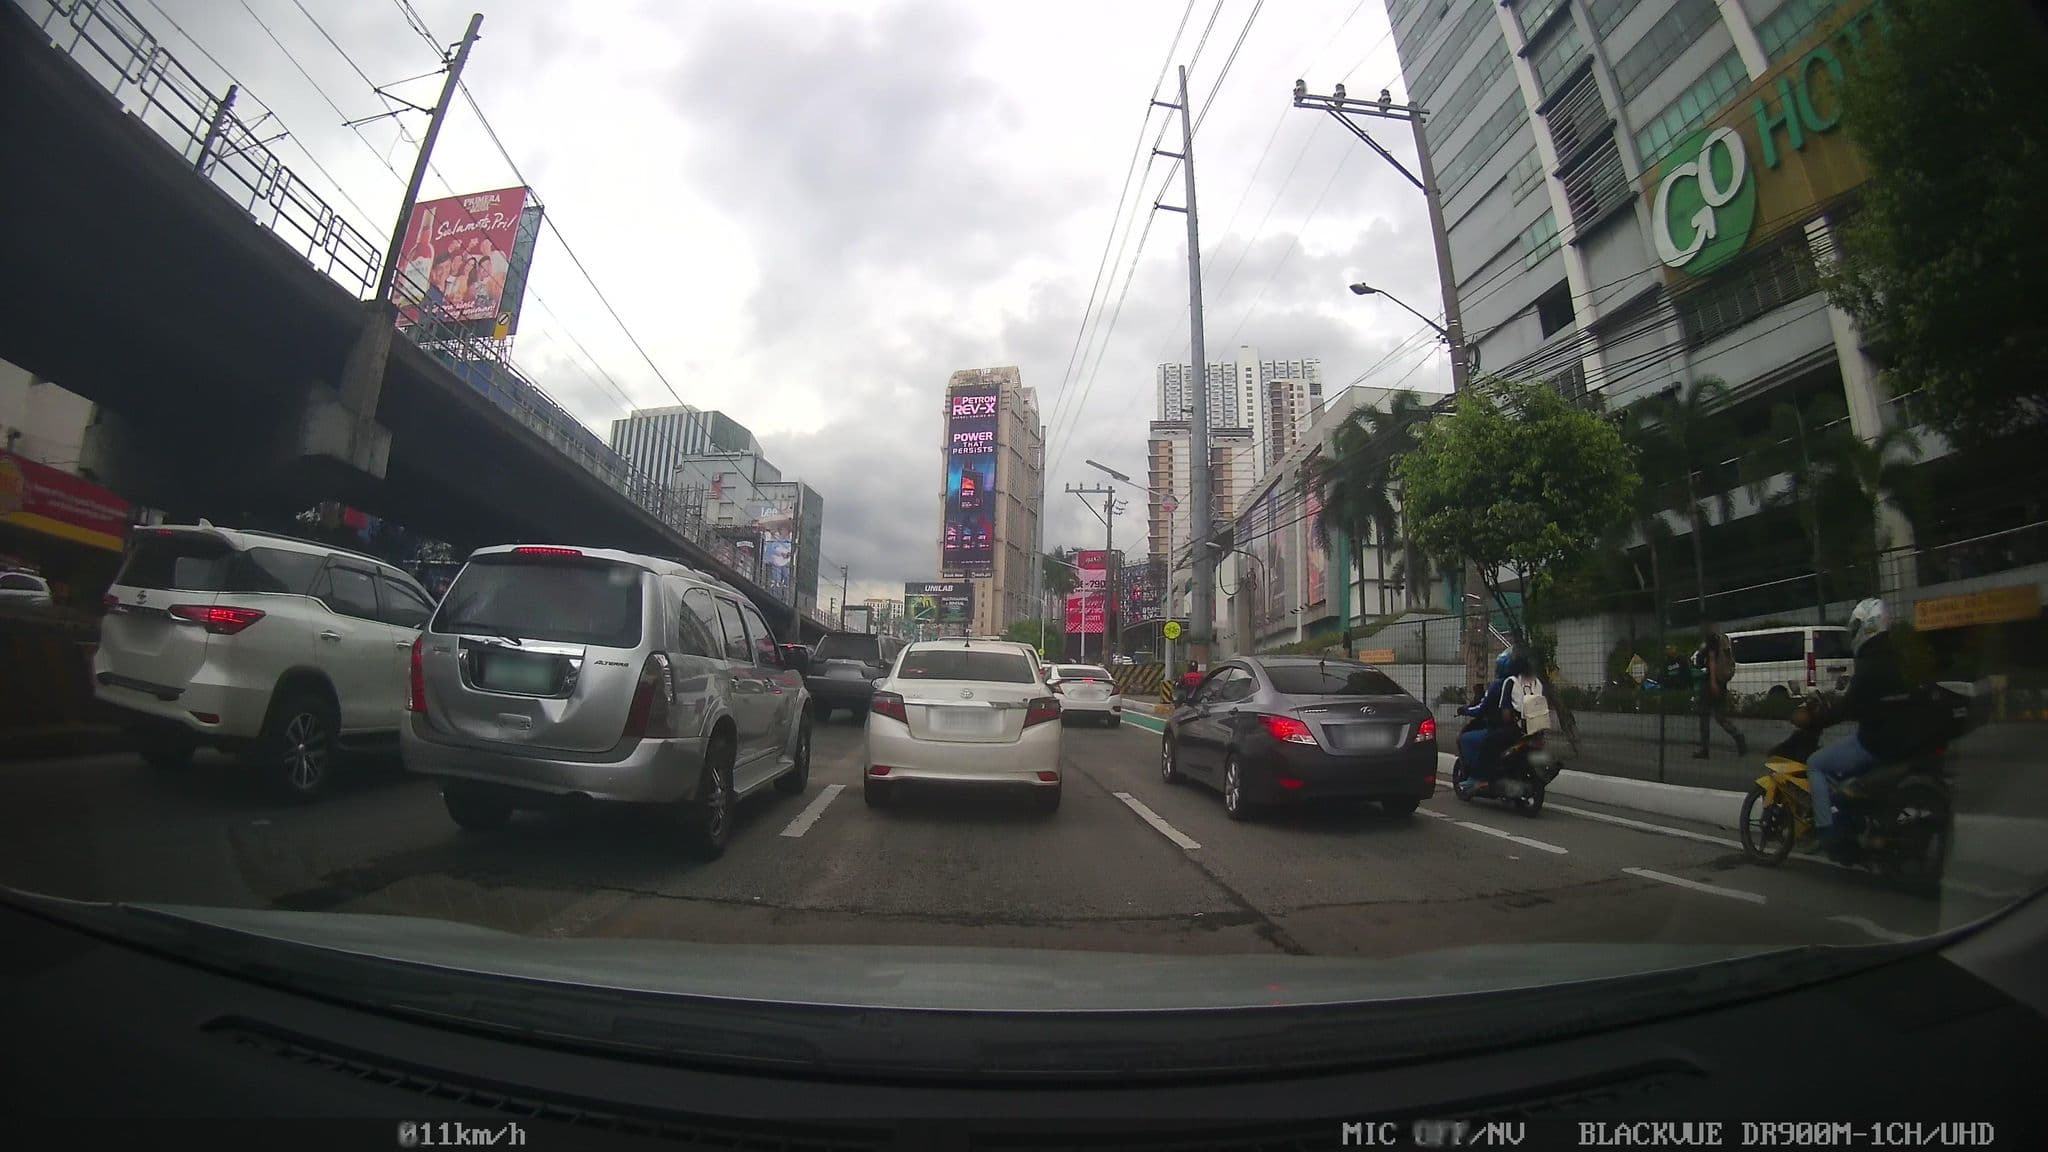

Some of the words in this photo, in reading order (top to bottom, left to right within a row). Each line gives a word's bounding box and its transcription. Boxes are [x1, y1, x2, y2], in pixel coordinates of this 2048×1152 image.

[1652, 126, 1747, 268] GO
[962, 396, 997, 405] PETRON
[952, 403, 996, 416] REV-X
[953, 432, 993, 443] POWER
[952, 446, 993, 454] PERSISTS
[761, 507, 778, 518] Lee
